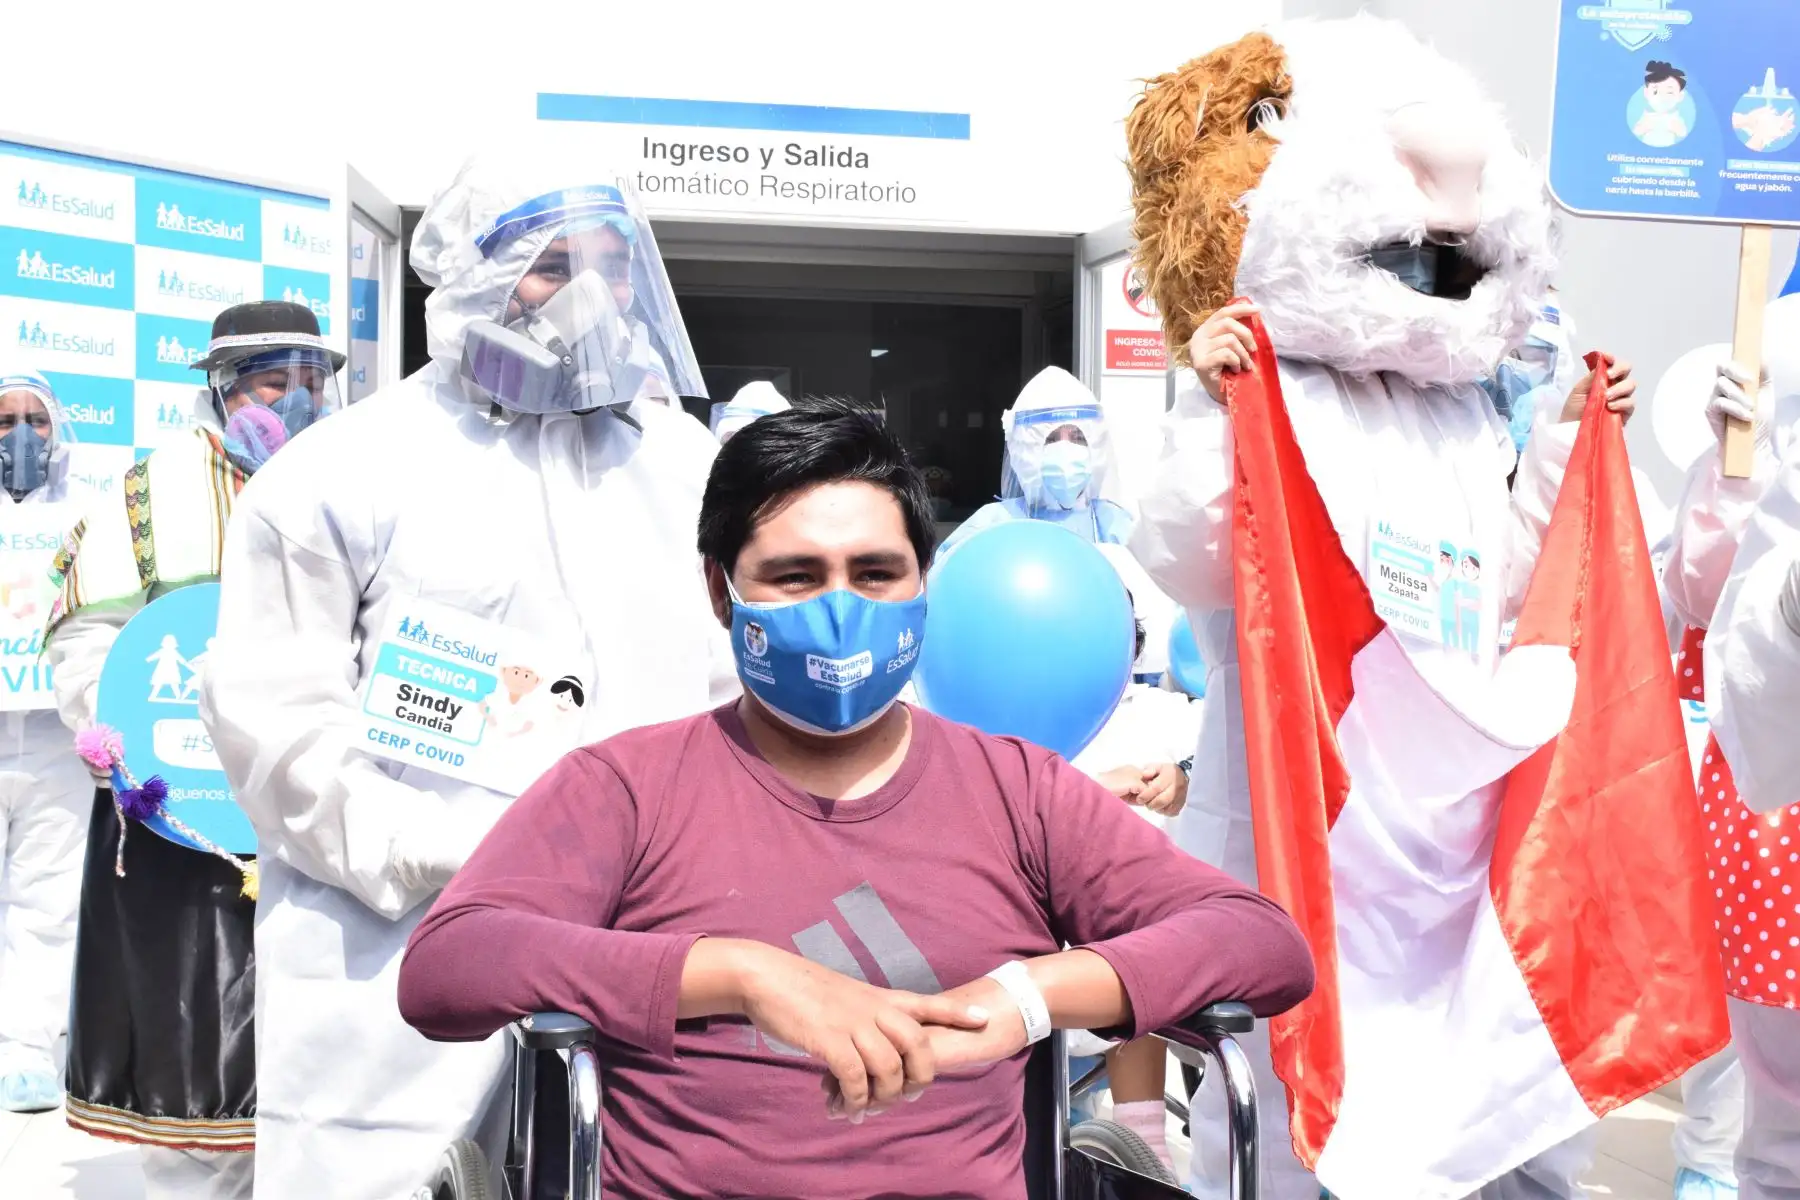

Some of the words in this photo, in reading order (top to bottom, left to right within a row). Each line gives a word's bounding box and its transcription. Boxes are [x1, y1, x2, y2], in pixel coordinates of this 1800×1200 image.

[642, 136, 749, 167] Ingreso
[759, 147, 774, 170] y
[784, 143, 870, 169] Salida
[1636, 156, 1704, 167] correctamente
[1612, 176, 1657, 185] cubriendo
[1719, 170, 1793, 181] frecuentemente
[760, 174, 916, 205] Respiratorio
[1735, 183, 1757, 192] agua
[52, 198, 115, 221] EsSalud
[188, 215, 244, 242] EsSalud
[51, 265, 115, 289] EsSalud
[188, 284, 244, 304] EsSalud
[52, 335, 115, 357] EsSalud
[1114, 338, 1156, 347] INGRESO
[12, 530, 64, 550] EsSal
[1380, 564, 1428, 592] Melissa
[1388, 582, 1420, 601] Zapata
[1403, 612, 1430, 630] COVID
[431, 633, 498, 667] EsSalud
[397, 654, 478, 694] TECNICA
[808, 655, 870, 673] #Vacunarse
[820, 668, 862, 684] EsSalud
[396, 683, 463, 721] Sindy
[395, 705, 453, 734] Candia
[367, 727, 411, 749] CERP
[415, 742, 465, 768] COVID
